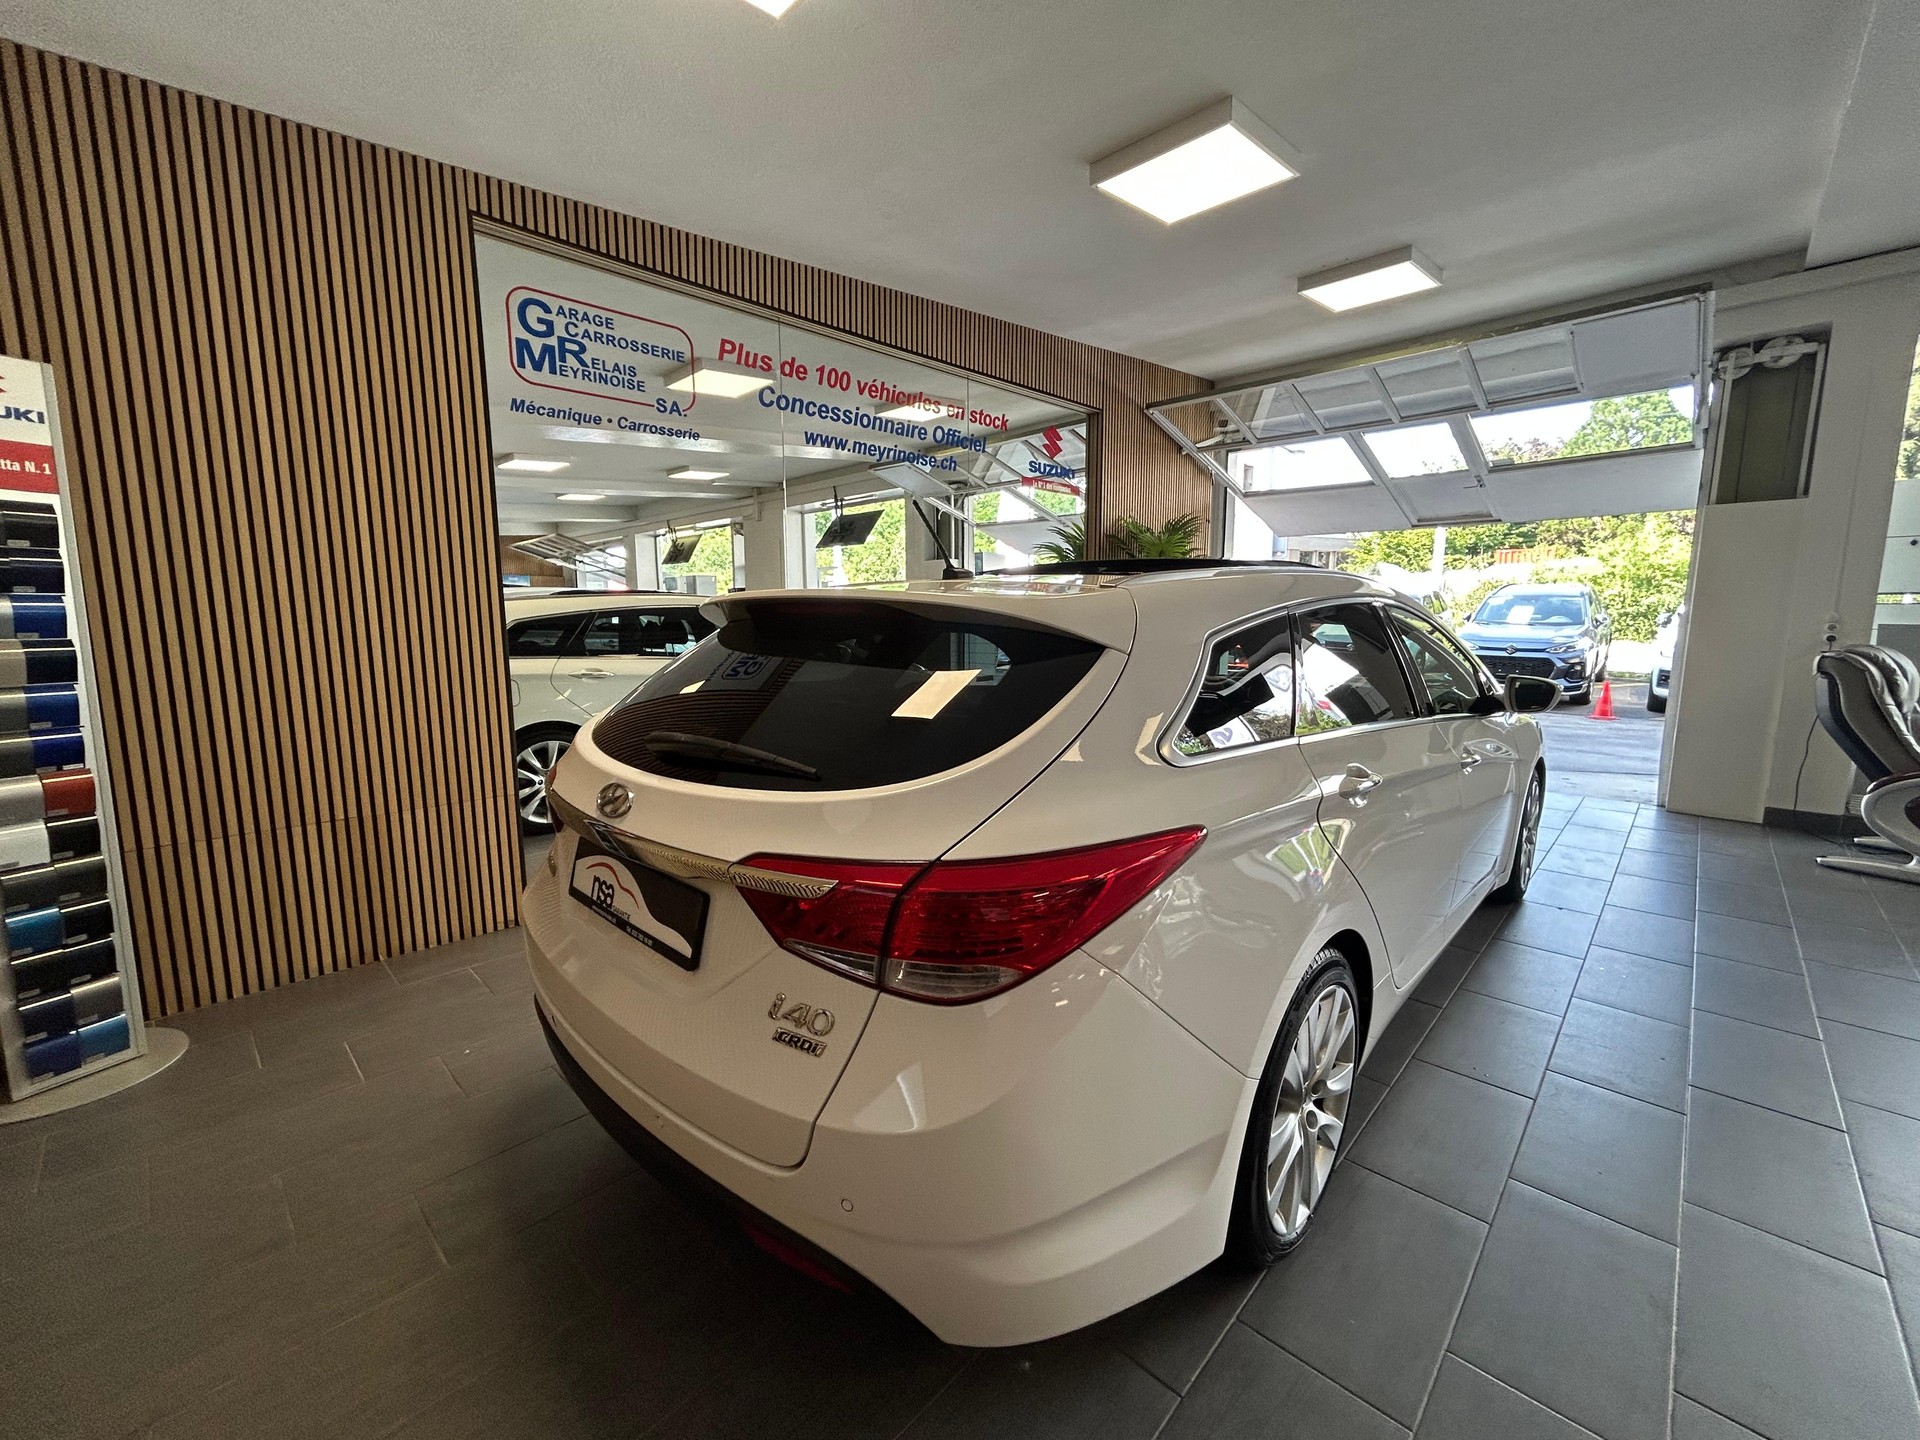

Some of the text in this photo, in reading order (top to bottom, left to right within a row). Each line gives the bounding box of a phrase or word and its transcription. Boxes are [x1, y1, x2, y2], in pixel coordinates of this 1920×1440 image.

[517, 298, 615, 338] GARAGE
[557, 336, 637, 378] RELAIS
[564, 322, 686, 363] CARROSSERIE
[515, 337, 646, 393] MEYRINOISE
[718, 338, 1010, 431] Plus de 100 véhicules en stock
[510, 398, 700, 441] Mécanique Carrosserie
[758, 385, 987, 453] Concessionnaire Officiel
[804, 428, 958, 472] www.meyrinoise.ch
[1028, 460, 1076, 480] SUZUKI
[768, 992, 835, 1036] i40
